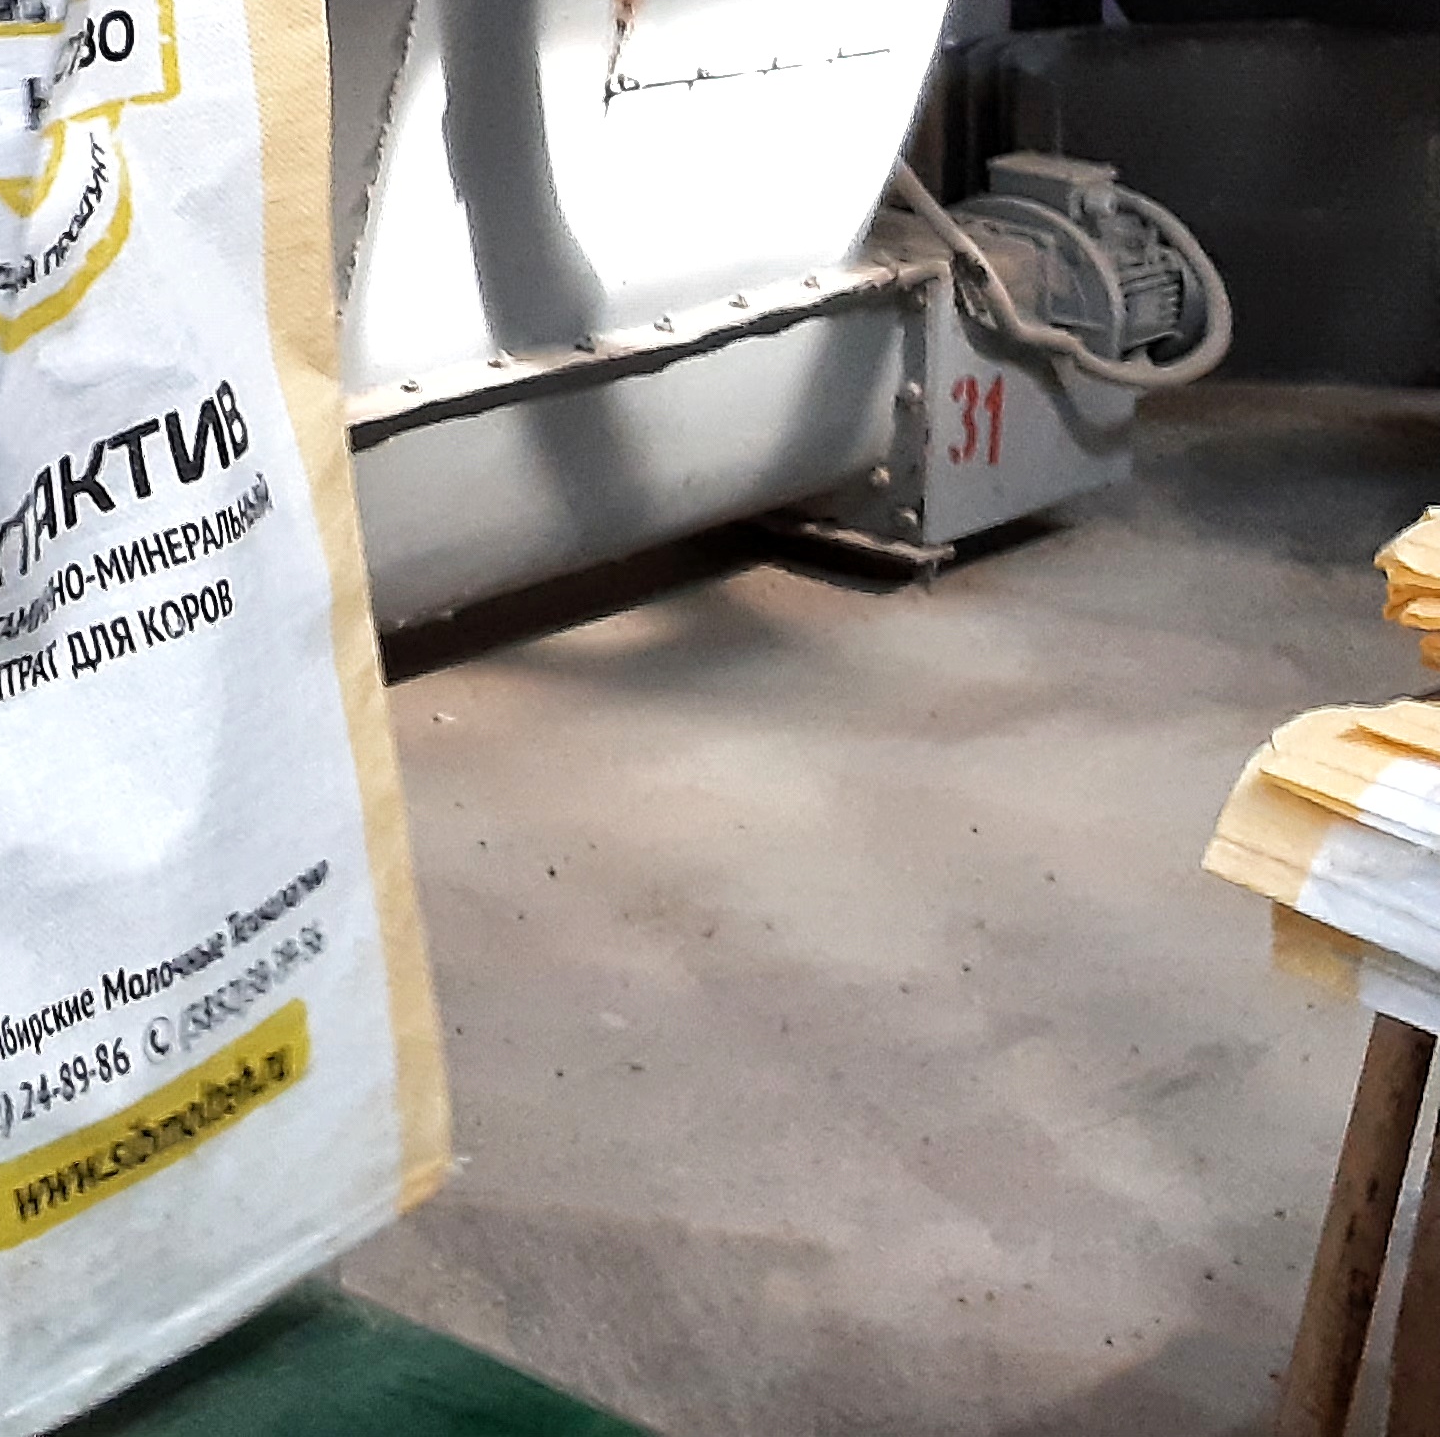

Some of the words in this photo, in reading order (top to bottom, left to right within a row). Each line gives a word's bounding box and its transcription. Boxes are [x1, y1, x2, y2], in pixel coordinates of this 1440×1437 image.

[947, 375, 1005, 466] 31
[68, 611, 137, 678] ДЛЯ
[145, 579, 234, 648] КОРОВ
